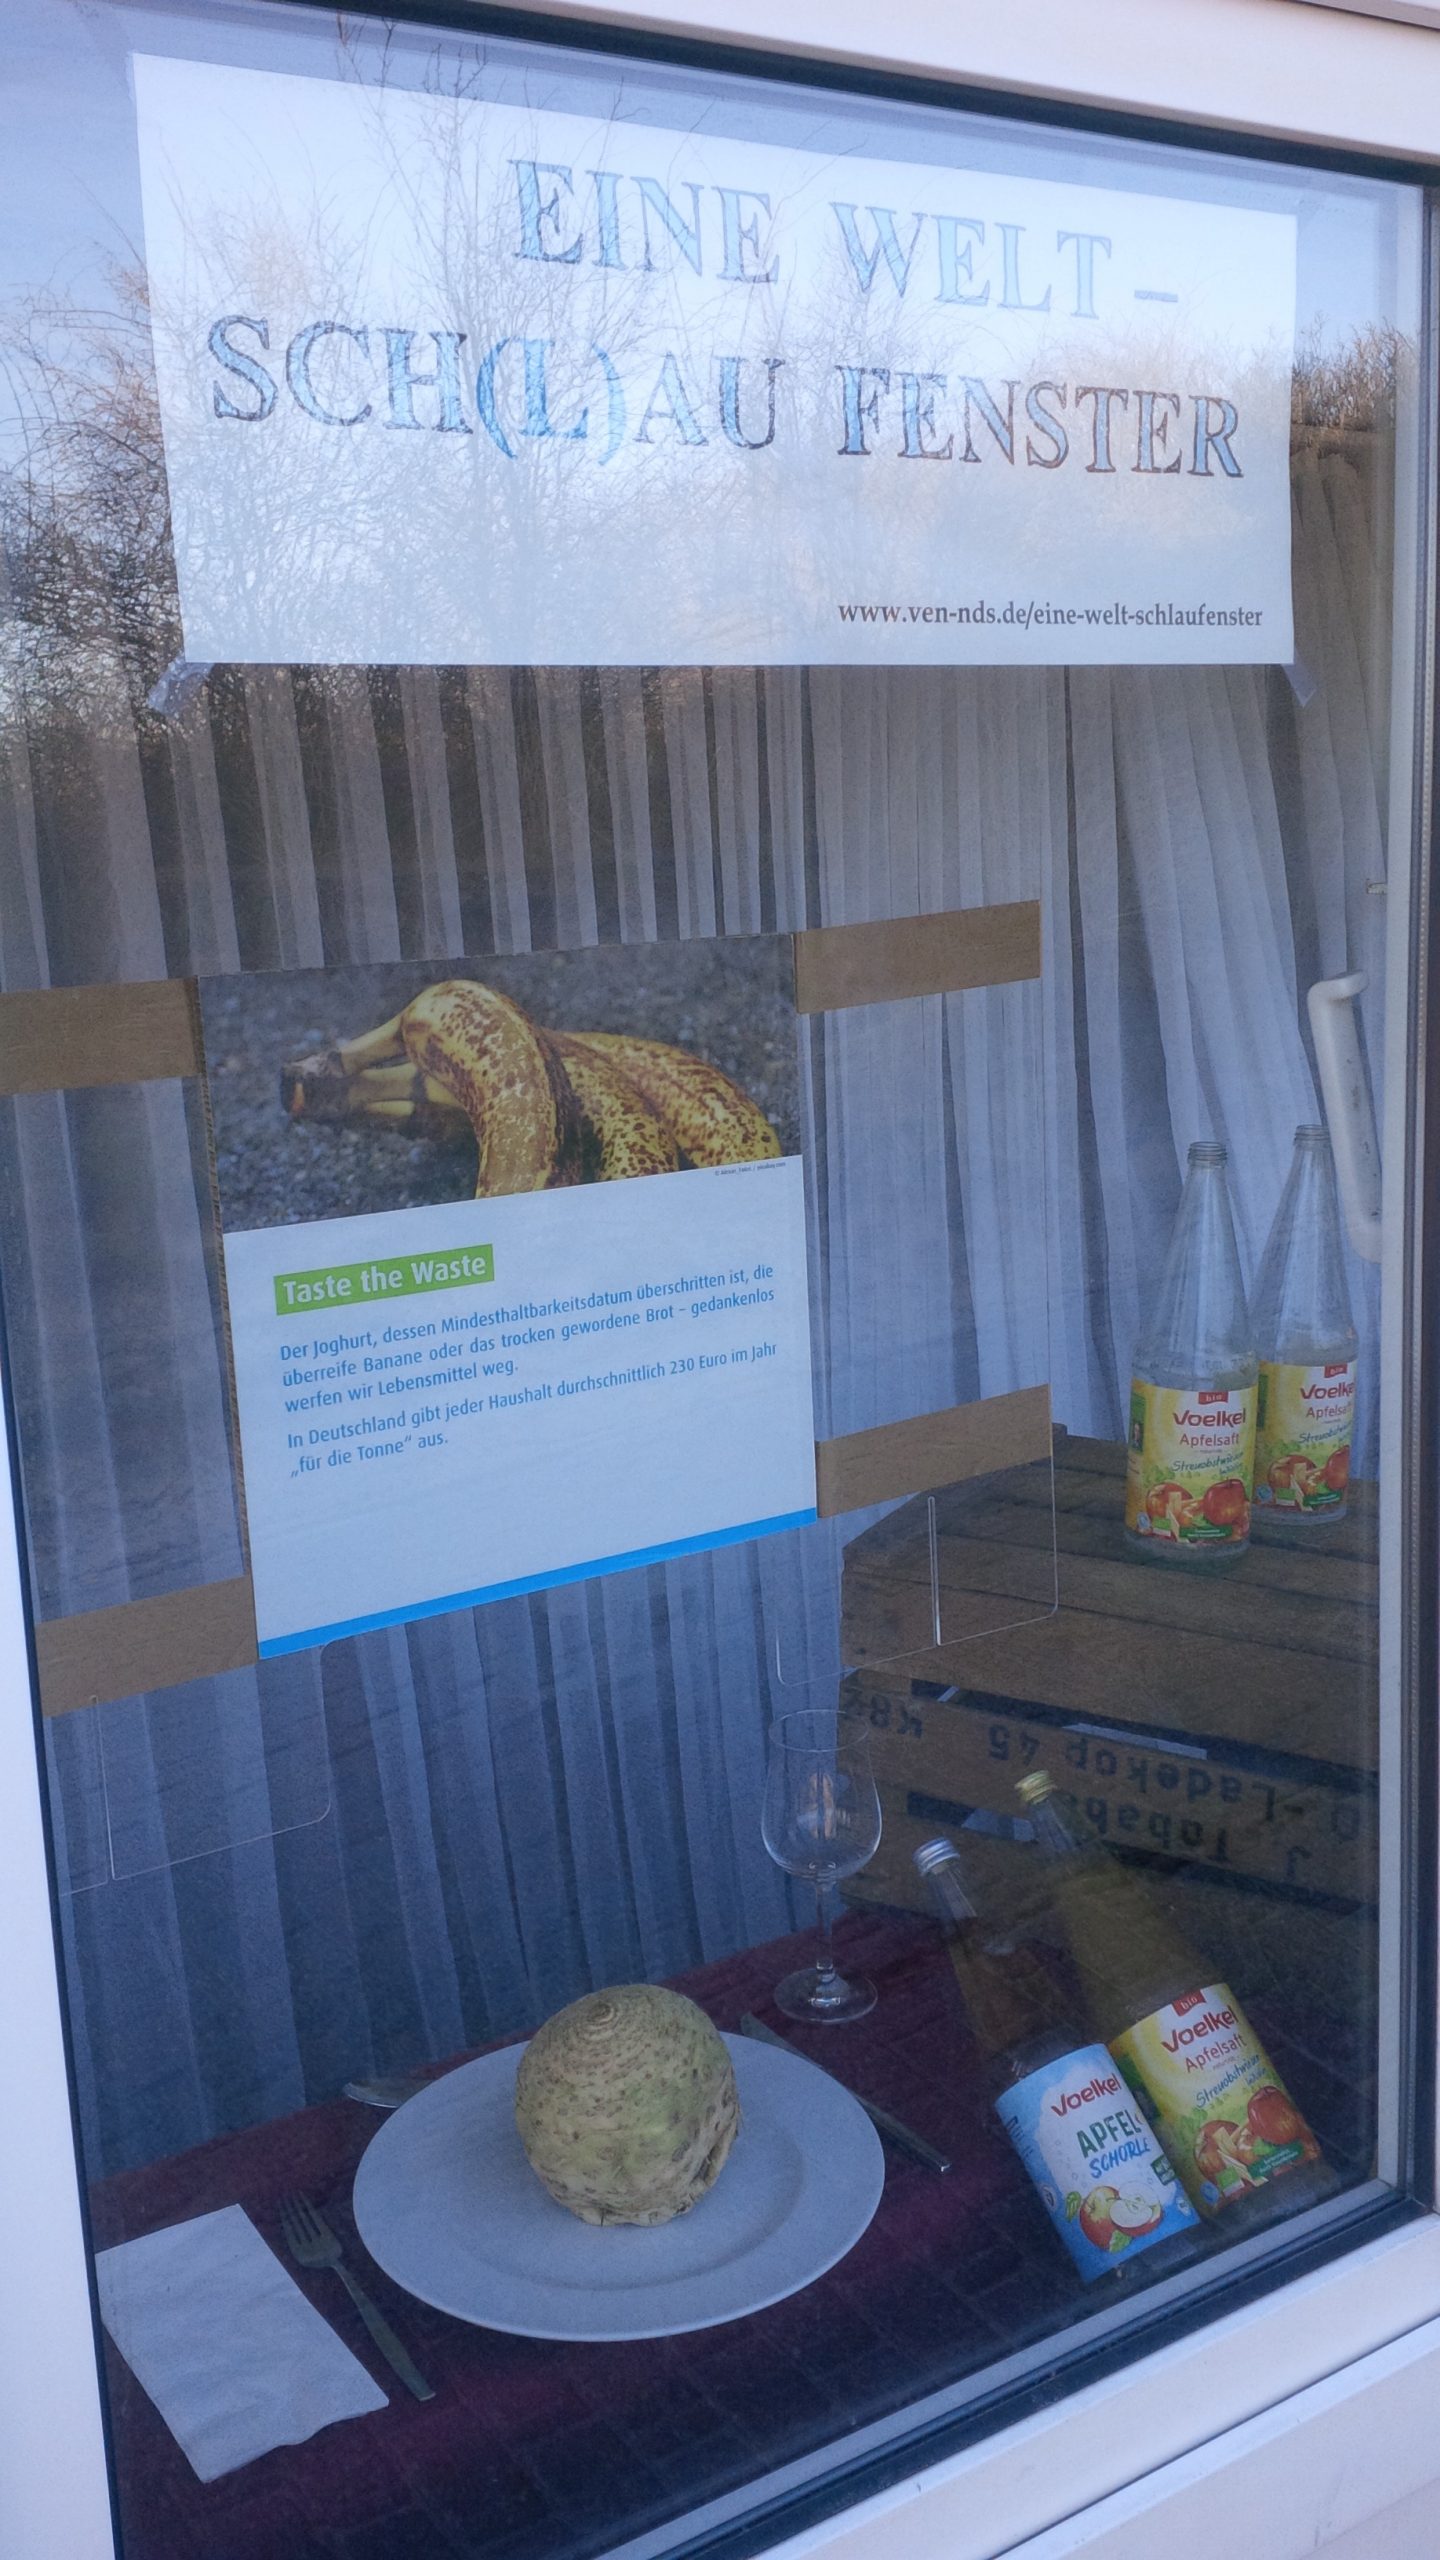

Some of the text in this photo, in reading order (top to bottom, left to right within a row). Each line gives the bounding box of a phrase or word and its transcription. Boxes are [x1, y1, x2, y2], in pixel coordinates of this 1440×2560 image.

[507, 160, 778, 284] EINE
[828, 201, 1112, 319] WELT
[207, 314, 1244, 478] SCH(L)AU FENSTER
[837, 599, 1263, 628] www.ven-nds.de/eine-welt-schlaufenster
[283, 1254, 486, 1305] Taste the Waste
[279, 1263, 774, 1361] Der Joghurt, dessen Mindesthaltbarkeitsdatum überschritten ist, die
[282, 1359, 358, 1387] überreife
[362, 1351, 423, 1373] Banane
[428, 1341, 464, 1361] oder
[469, 1336, 496, 1354] das
[500, 1327, 556, 1349] trocken
[560, 1312, 641, 1342] gewordene
[645, 1304, 675, 1323] Brot
[690, 1287, 775, 1319] gedankenlos
[284, 1359, 519, 1413] werfen wir Lebensmittel weg.
[287, 1341, 777, 1449] In Deutschland gibt jeder Haushalt durchschnittlich 230 Euro im Jahr
[1173, 1407, 1246, 1428] Voelkel
[1306, 1402, 1352, 1421] Apfelsa
[327, 1449, 352, 1467] die
[417, 1432, 449, 1449] aus.
[1180, 1433, 1240, 1448] Apfelsaft
[988, 1722, 1041, 1767] 45
[1161, 2004, 1239, 2053] Voelkel
[1185, 2032, 1248, 2074] Apfelsaft
[1051, 2073, 1122, 2117] Voelkel
[1077, 2109, 1142, 2159] APFEL
[1089, 2137, 1151, 2179] SCHORLE
